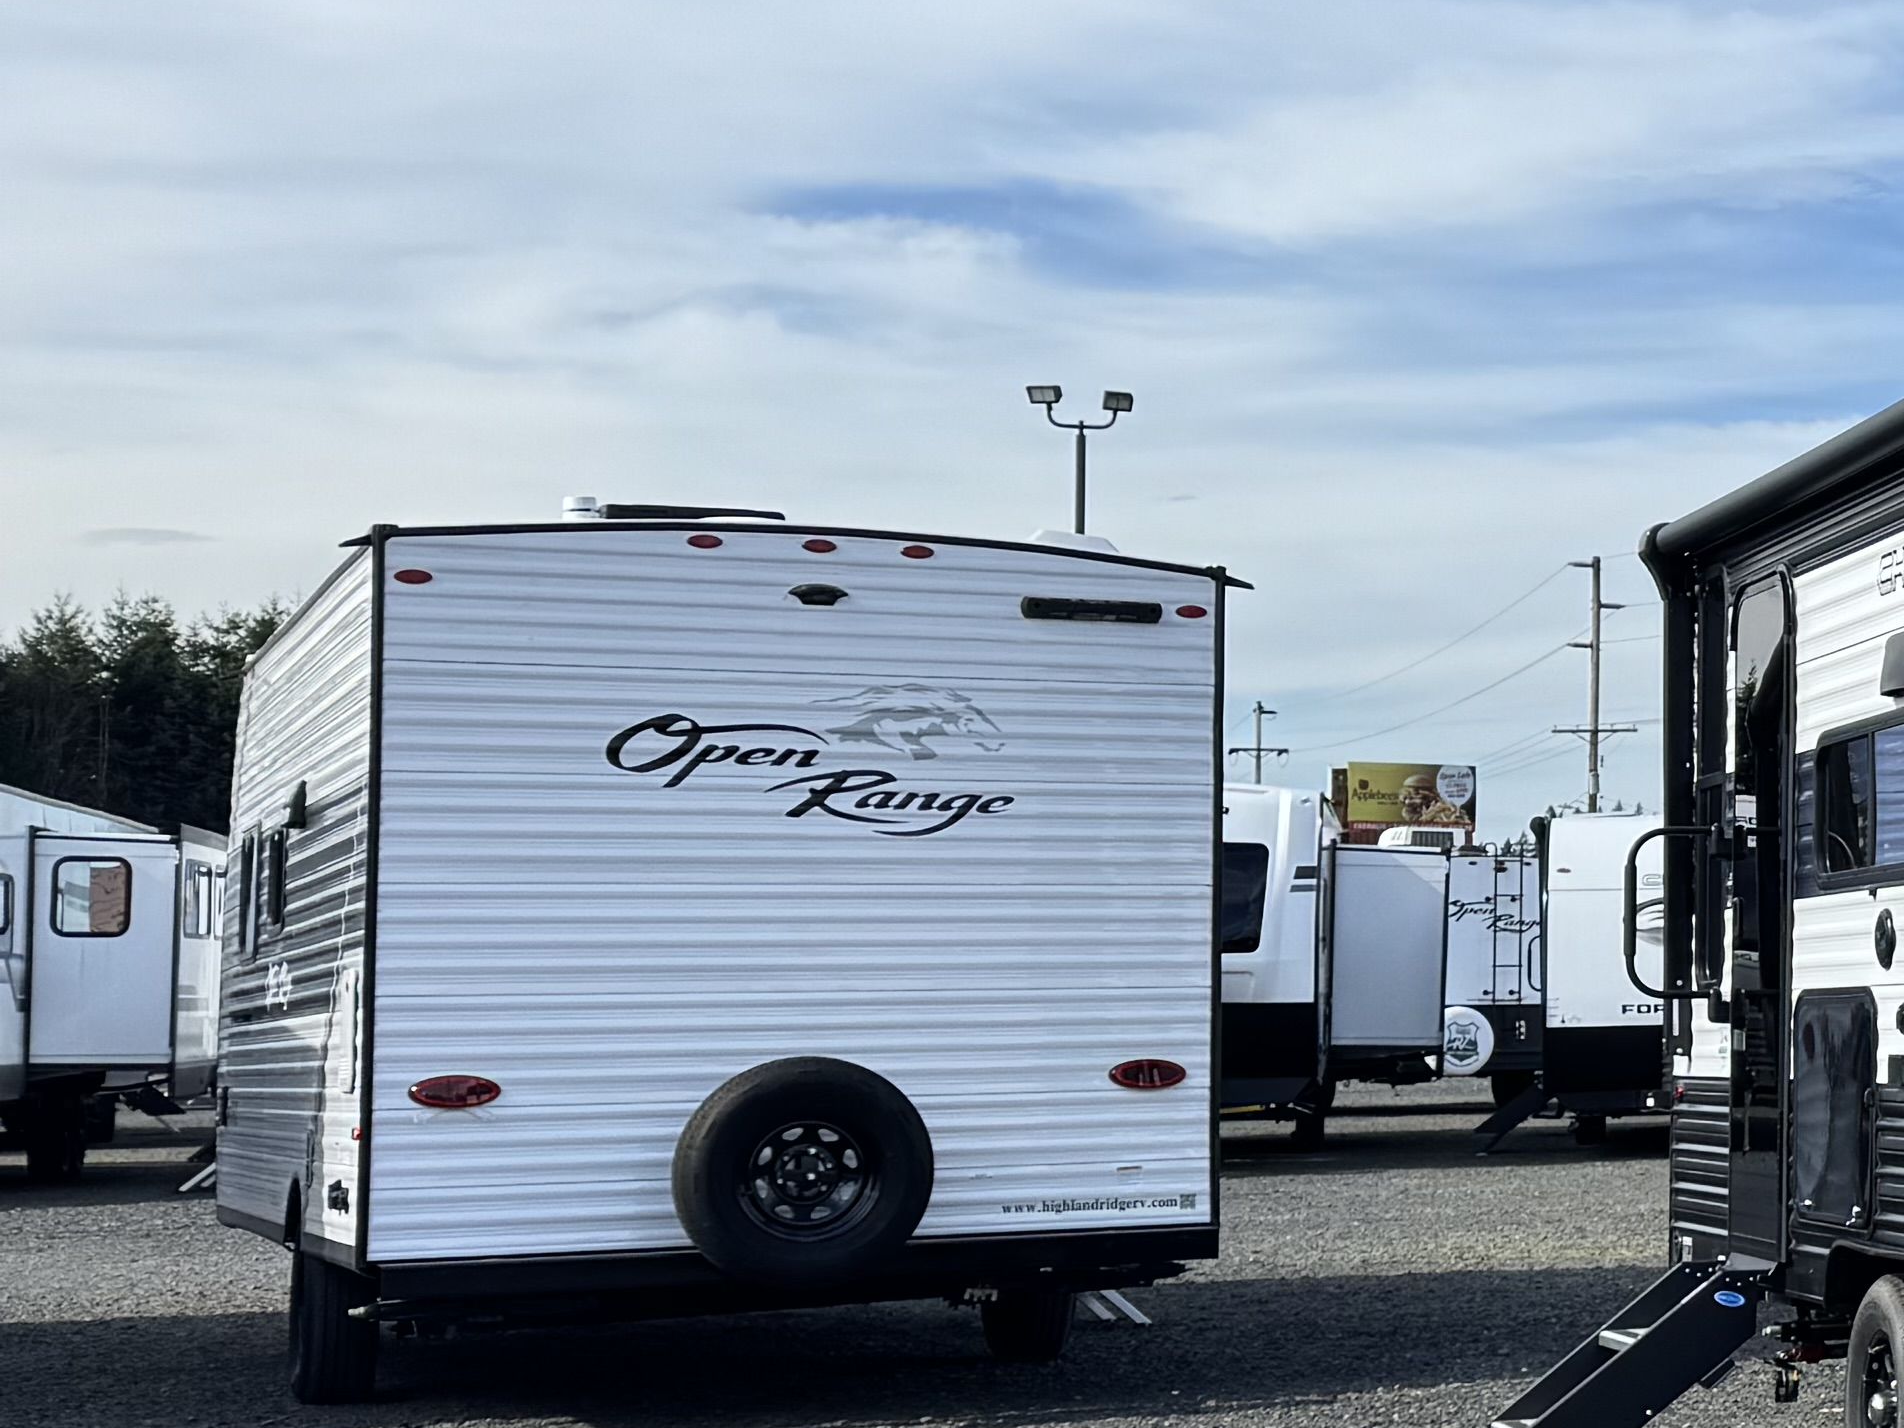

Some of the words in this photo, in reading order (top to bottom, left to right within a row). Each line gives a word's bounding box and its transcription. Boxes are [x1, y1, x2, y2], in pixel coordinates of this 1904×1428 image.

[605, 713, 830, 788] Open
[764, 769, 1015, 837] Range
[1001, 1196, 1179, 1215] www.highlandridgerv.com
